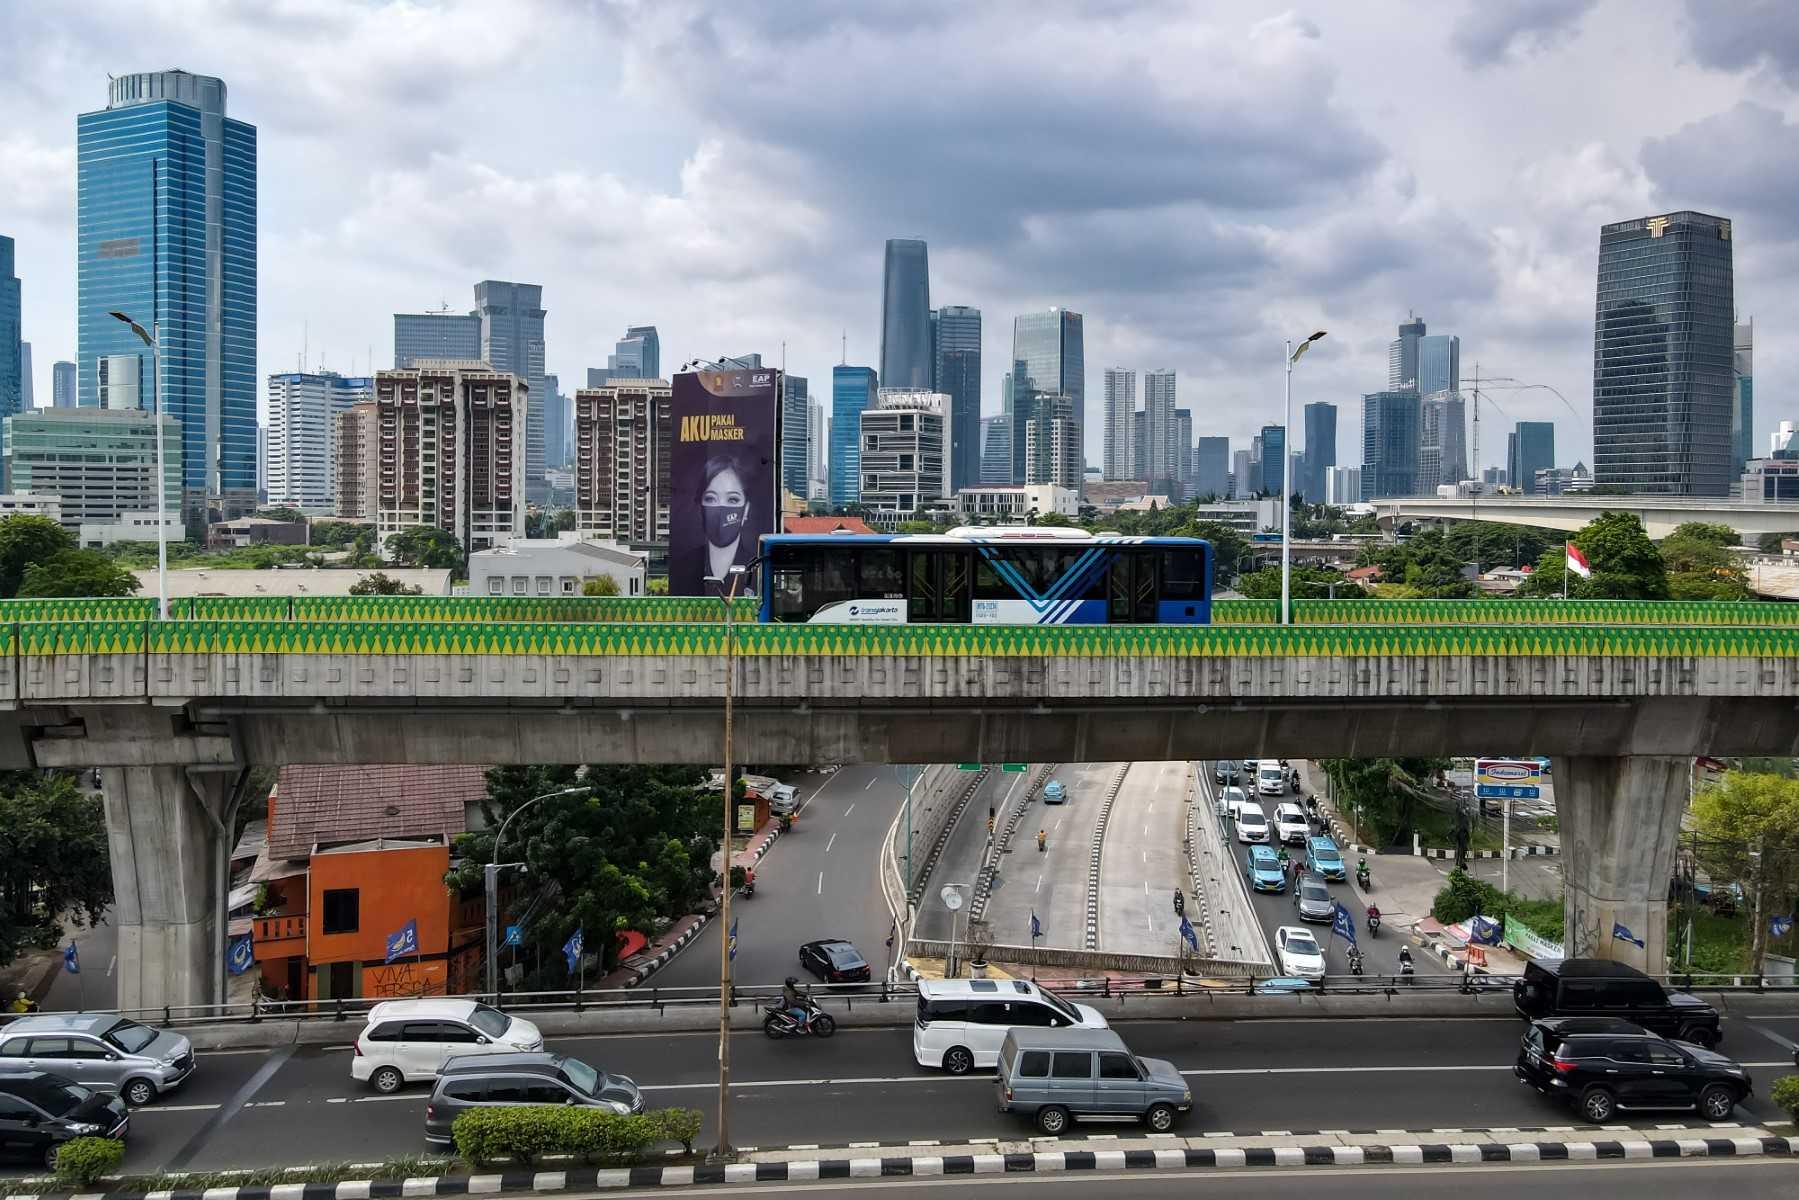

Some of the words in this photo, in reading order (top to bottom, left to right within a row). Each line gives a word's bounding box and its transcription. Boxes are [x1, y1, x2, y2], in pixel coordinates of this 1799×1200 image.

[752, 375, 770, 383] EAP
[711, 414, 735, 426] PAKAI
[680, 415, 711, 442] AKU
[710, 428, 744, 441] MASKER
[371, 963, 414, 984] VIVA
